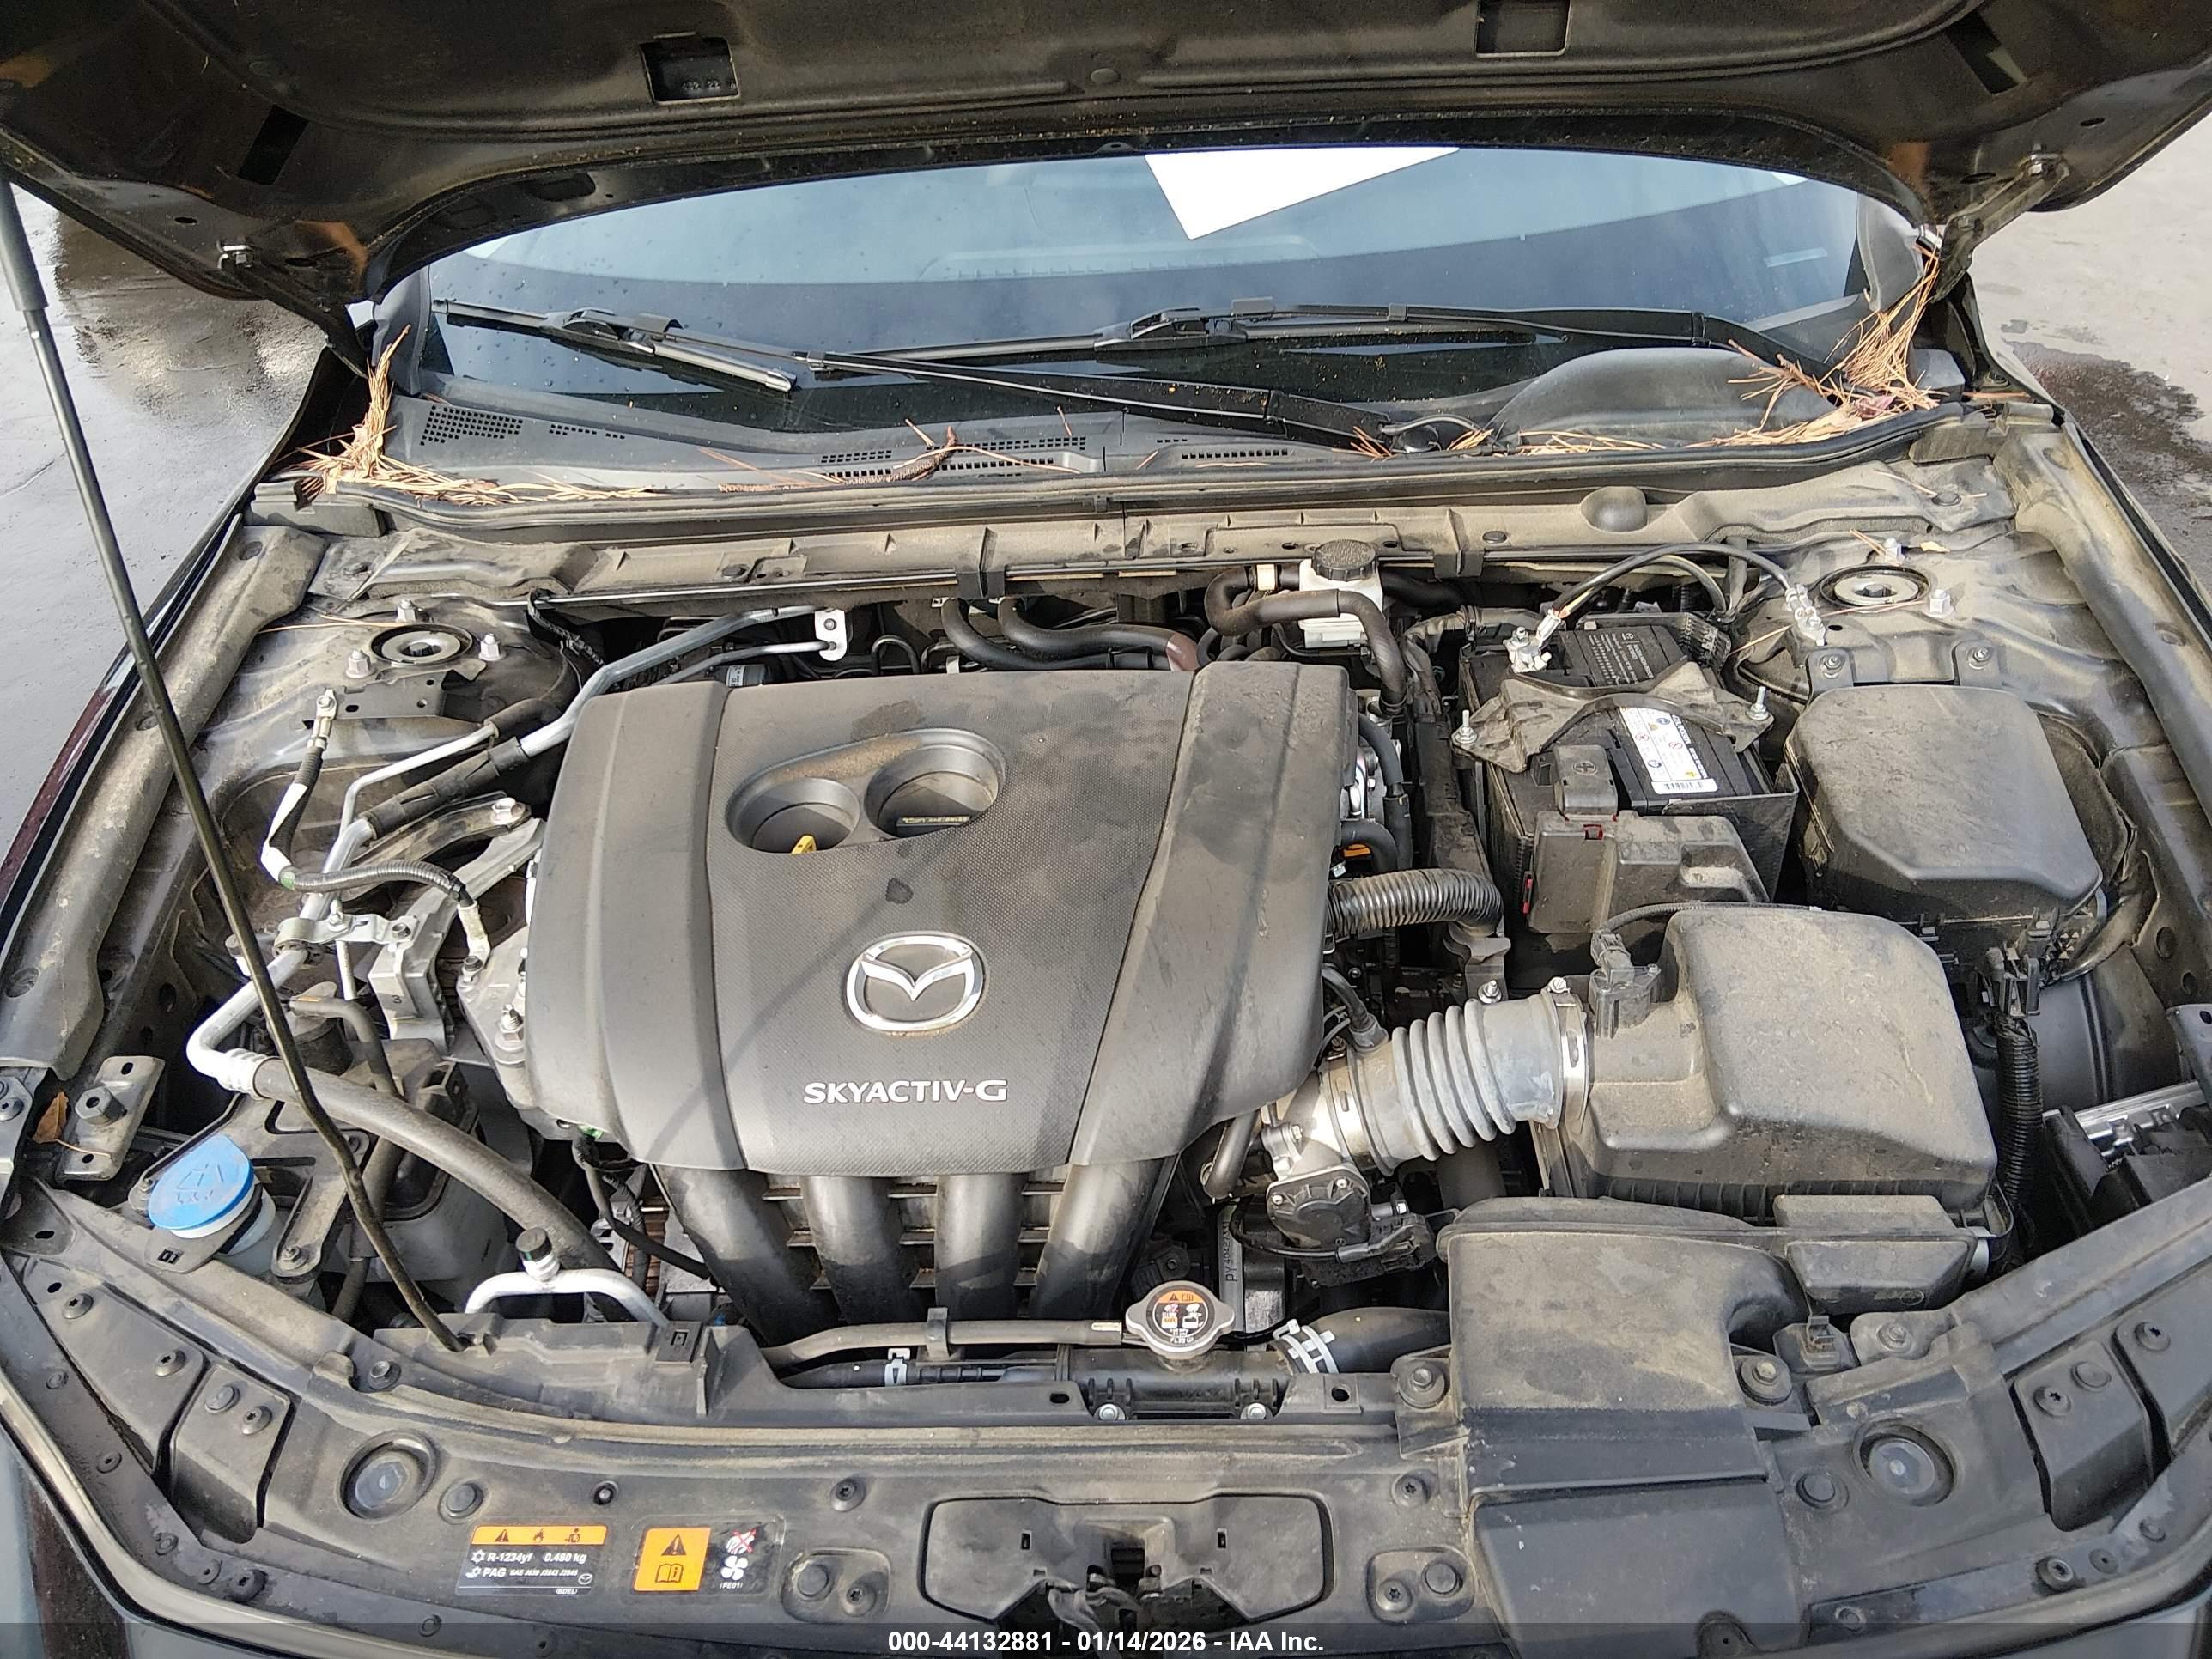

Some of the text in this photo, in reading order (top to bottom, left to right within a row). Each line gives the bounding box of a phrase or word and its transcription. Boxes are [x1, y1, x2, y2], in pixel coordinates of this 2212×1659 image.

[392, 994, 402, 1004] 3
[804, 1079, 1007, 1103] SKYACTIV-G
[487, 1552, 587, 1564] R-1234yf 0.480 kg
[483, 1567, 507, 1578] PAG
